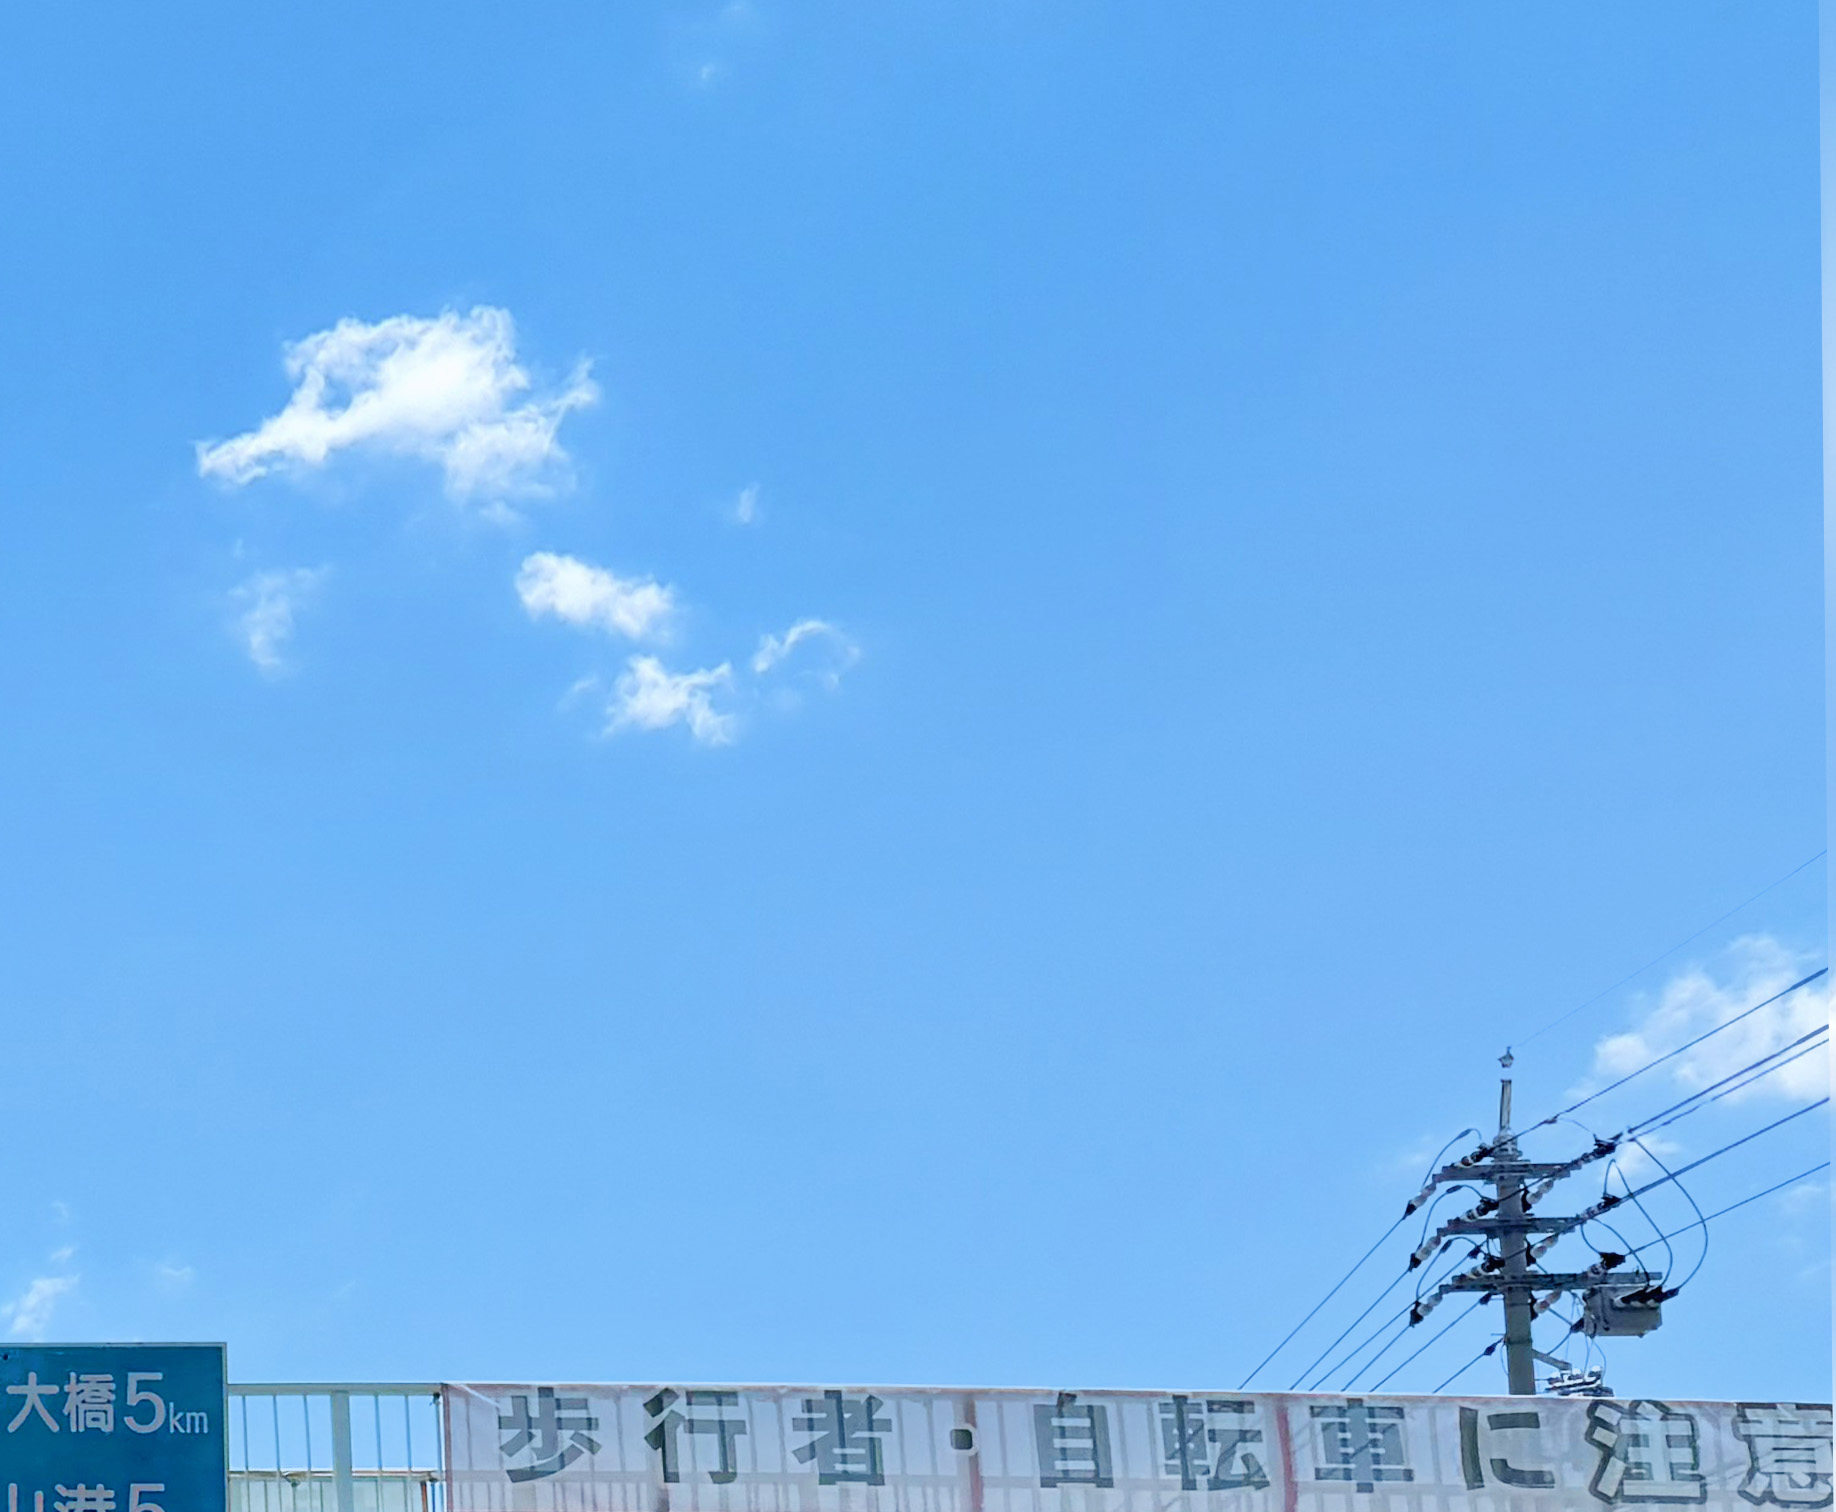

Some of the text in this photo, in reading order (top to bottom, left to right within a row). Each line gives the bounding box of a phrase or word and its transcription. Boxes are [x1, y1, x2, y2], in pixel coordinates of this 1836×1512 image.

[499, 1387, 1834, 1509] 歩行者・自転車に注意
